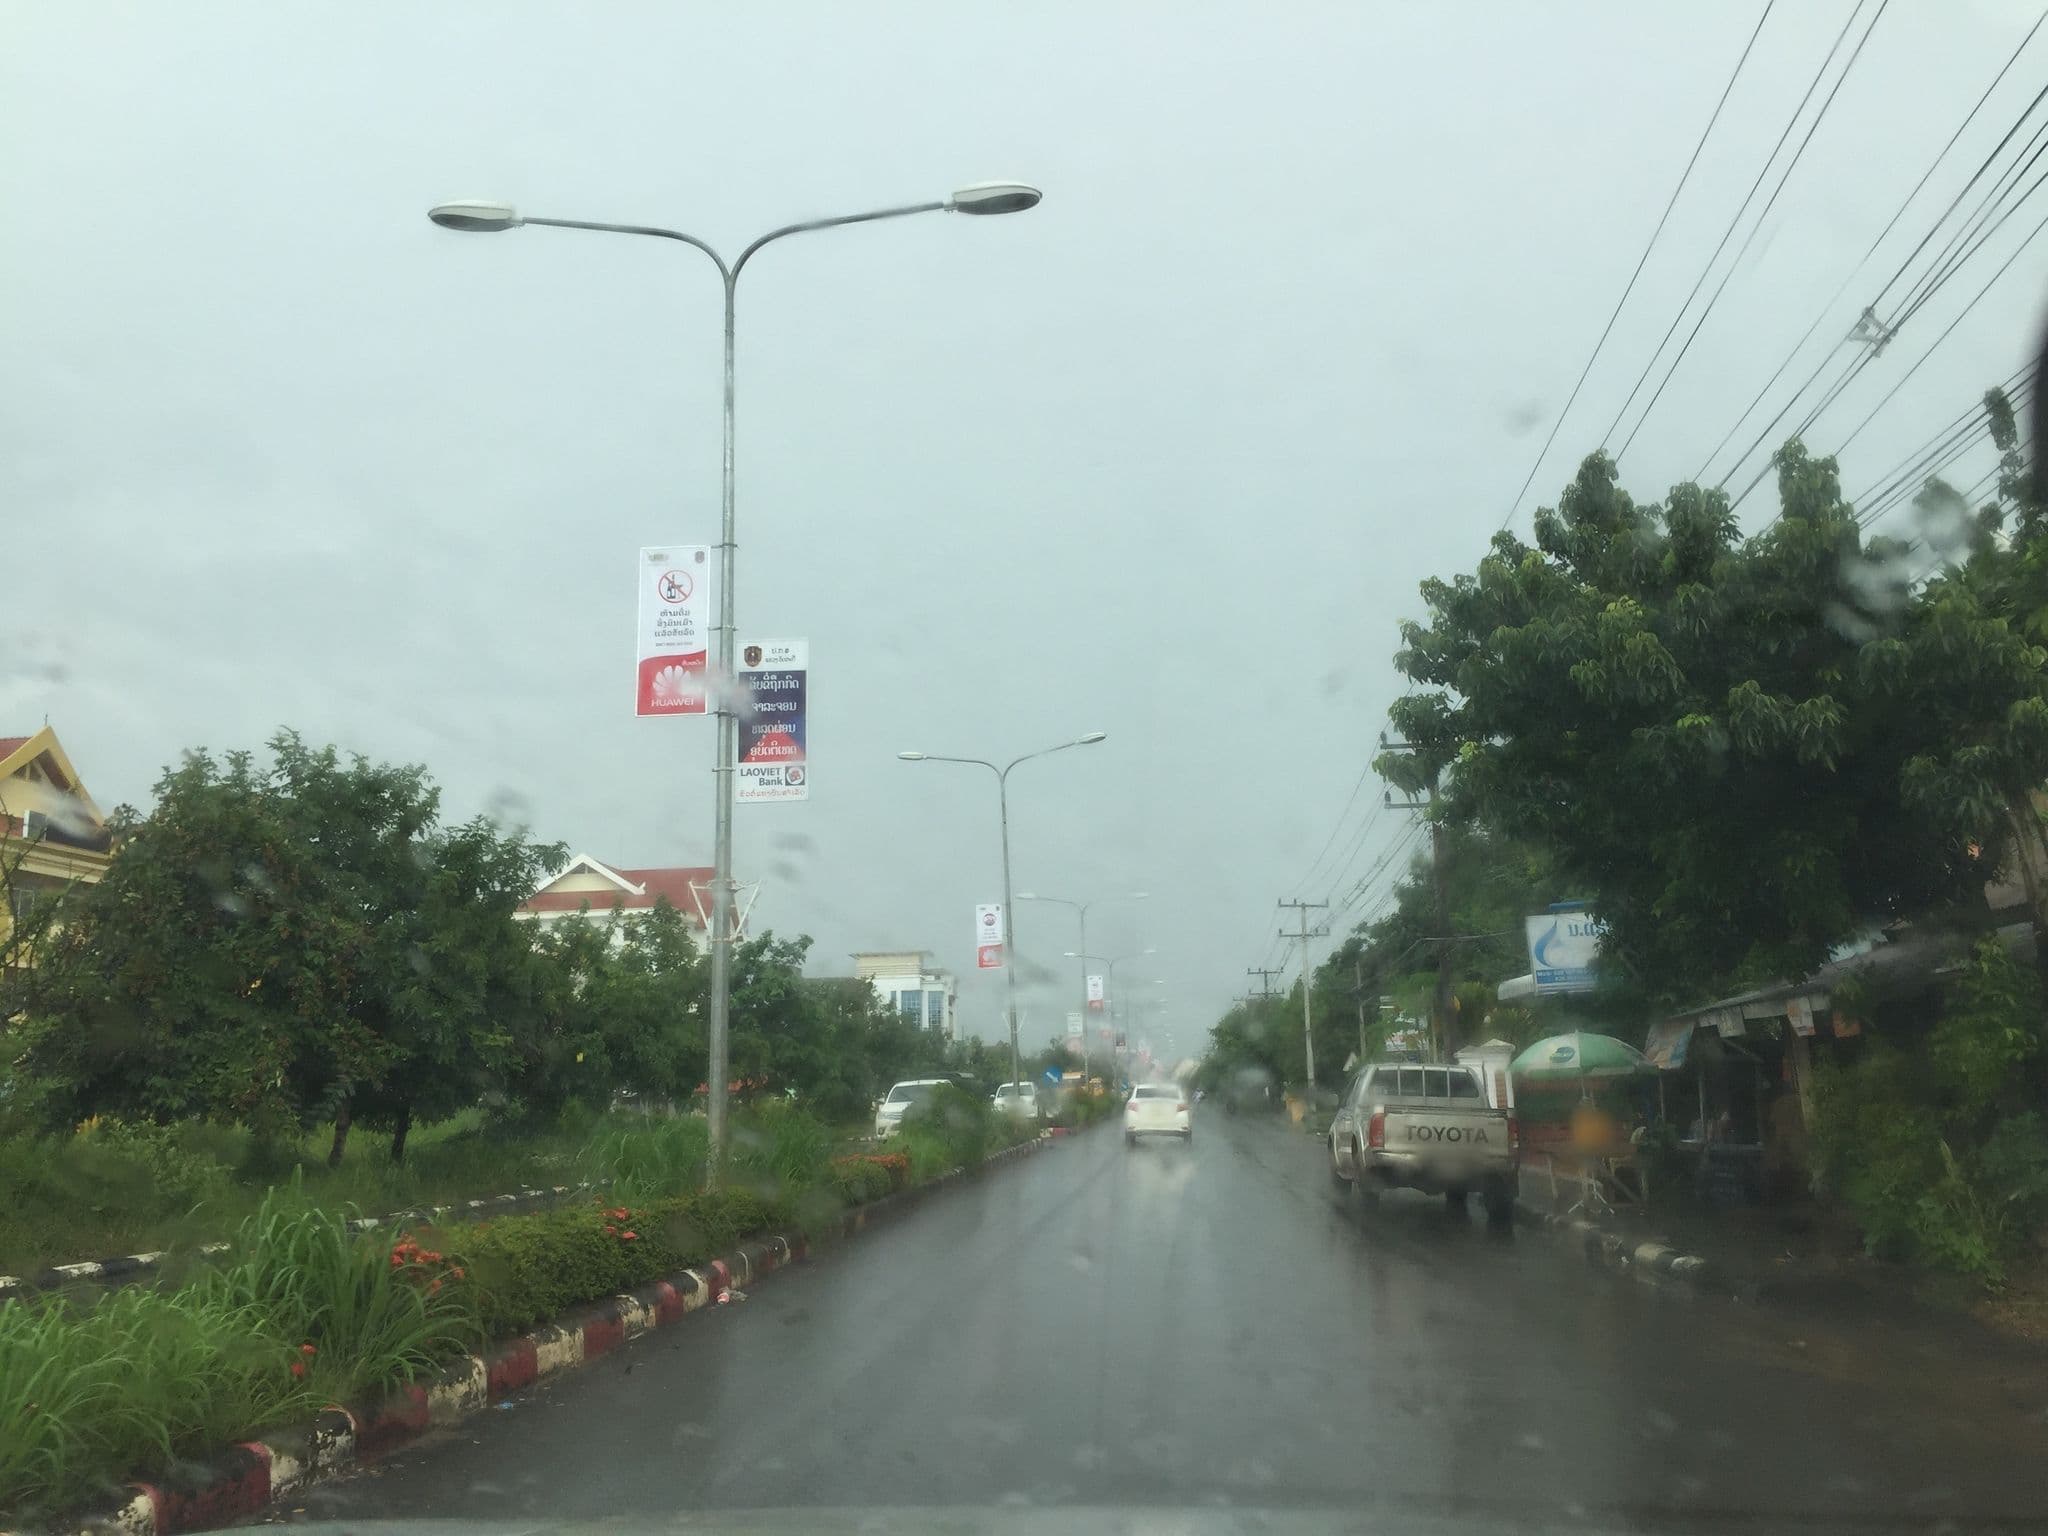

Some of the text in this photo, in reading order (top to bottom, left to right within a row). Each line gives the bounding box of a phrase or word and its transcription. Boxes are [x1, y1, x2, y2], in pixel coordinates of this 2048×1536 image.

[651, 698, 694, 707] HUAWEI
[740, 767, 781, 777] LAOVIET
[759, 777, 783, 786] Bank
[1405, 1125, 1489, 1143] TOYOTA
